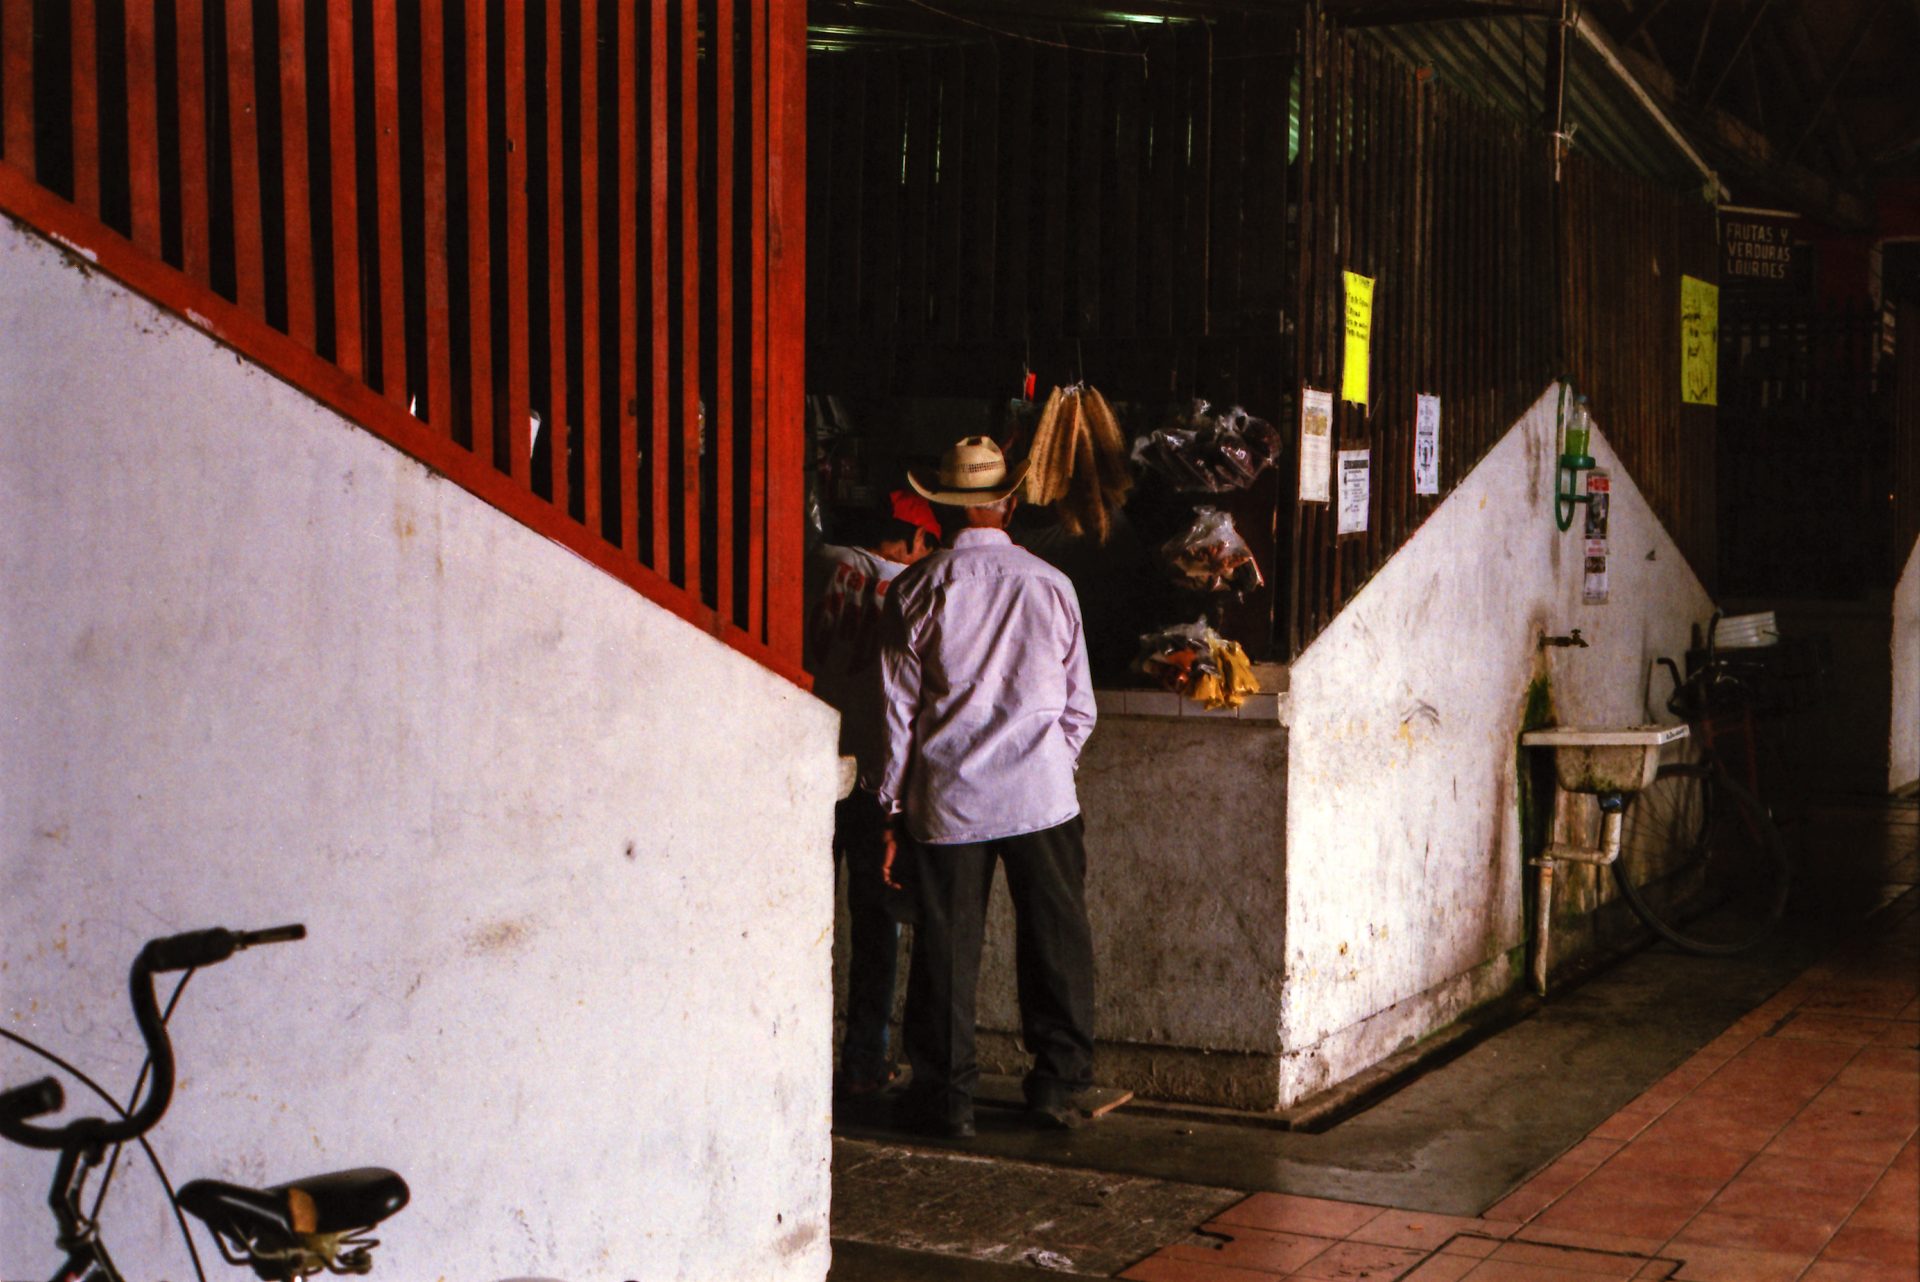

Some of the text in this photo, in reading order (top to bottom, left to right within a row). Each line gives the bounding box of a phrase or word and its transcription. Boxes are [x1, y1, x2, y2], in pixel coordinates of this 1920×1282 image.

[1727, 224, 1789, 244] FRUTAS Y
[1728, 242, 1791, 262] VERDURAS
[1728, 259, 1785, 279] LOURDES
